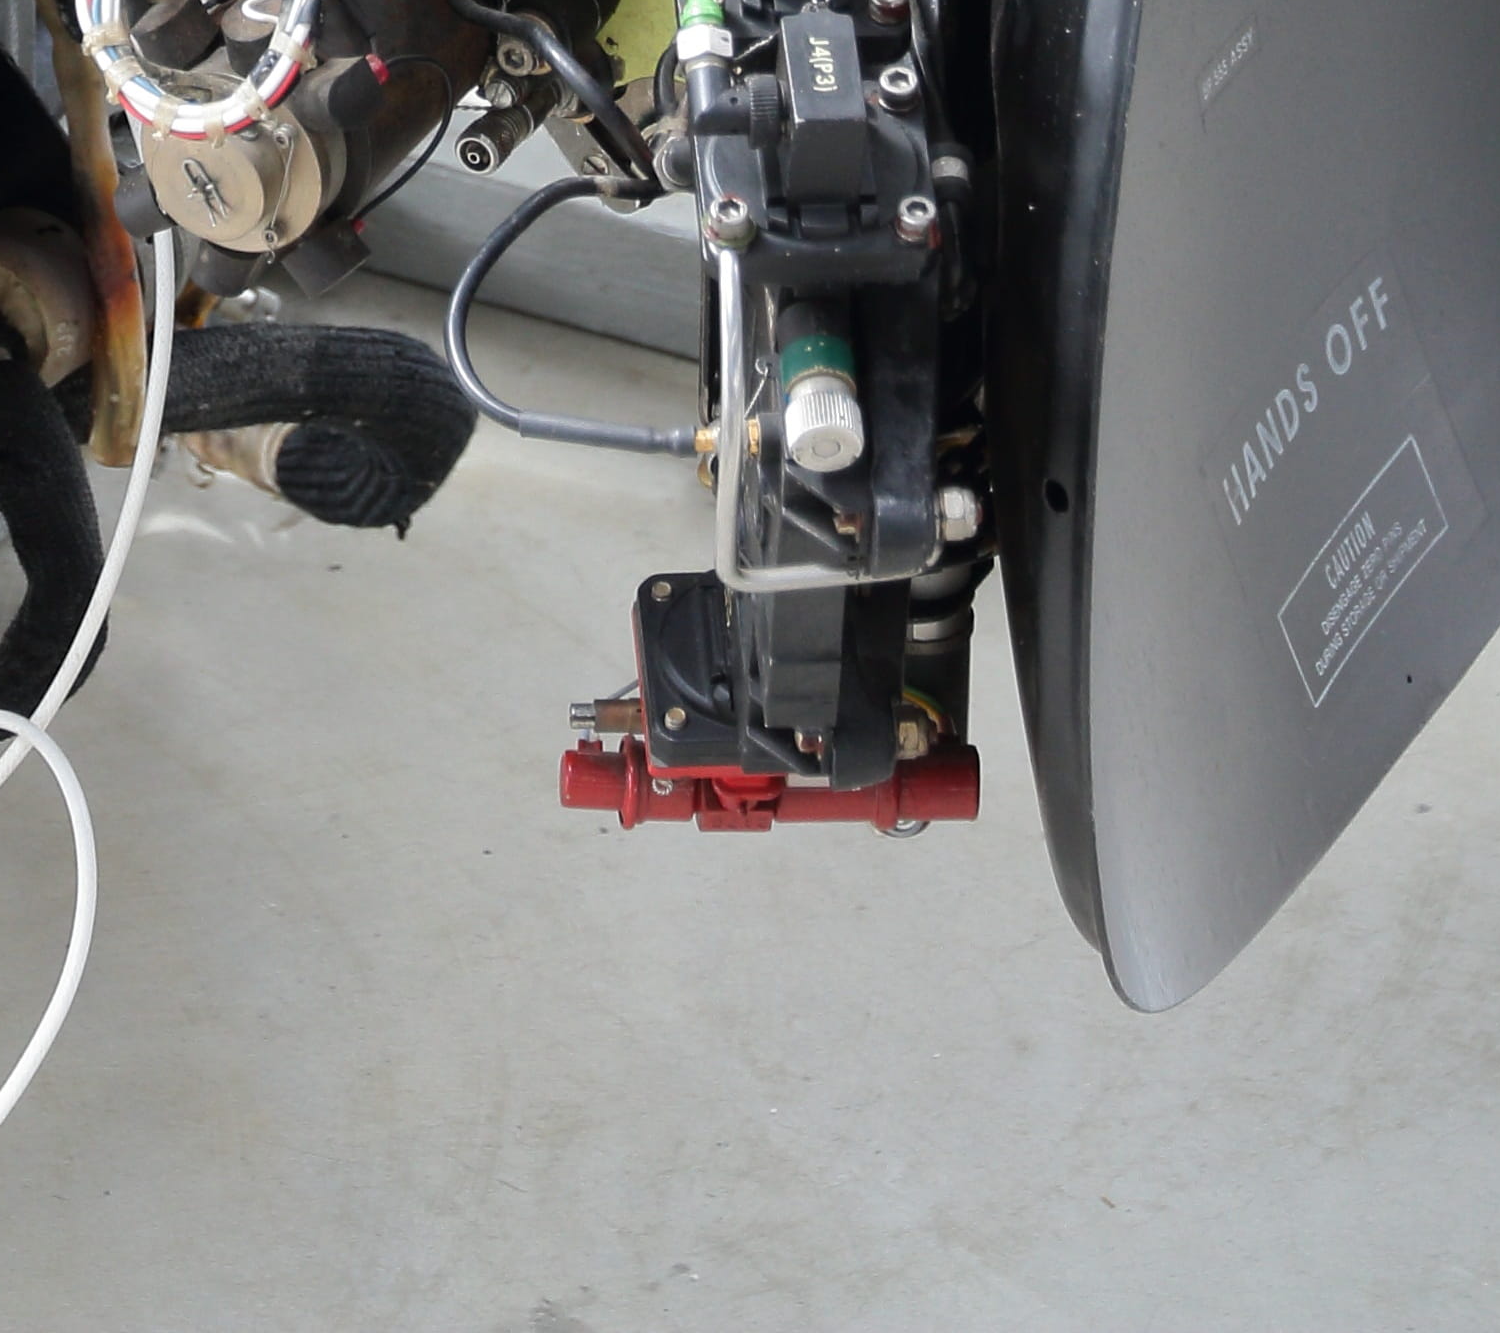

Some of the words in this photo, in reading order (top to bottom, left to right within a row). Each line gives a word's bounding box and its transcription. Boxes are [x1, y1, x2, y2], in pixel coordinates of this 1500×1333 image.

[810, 38, 836, 91] J4(P3)
[1221, 363, 1321, 528] HANDS
[1325, 276, 1392, 376] OFF
[1322, 507, 1377, 593] CAUTION
[1313, 629, 1345, 679] DURING
[1339, 582, 1376, 640] STORAGE
[1319, 570, 1363, 637] DISENGAGE
